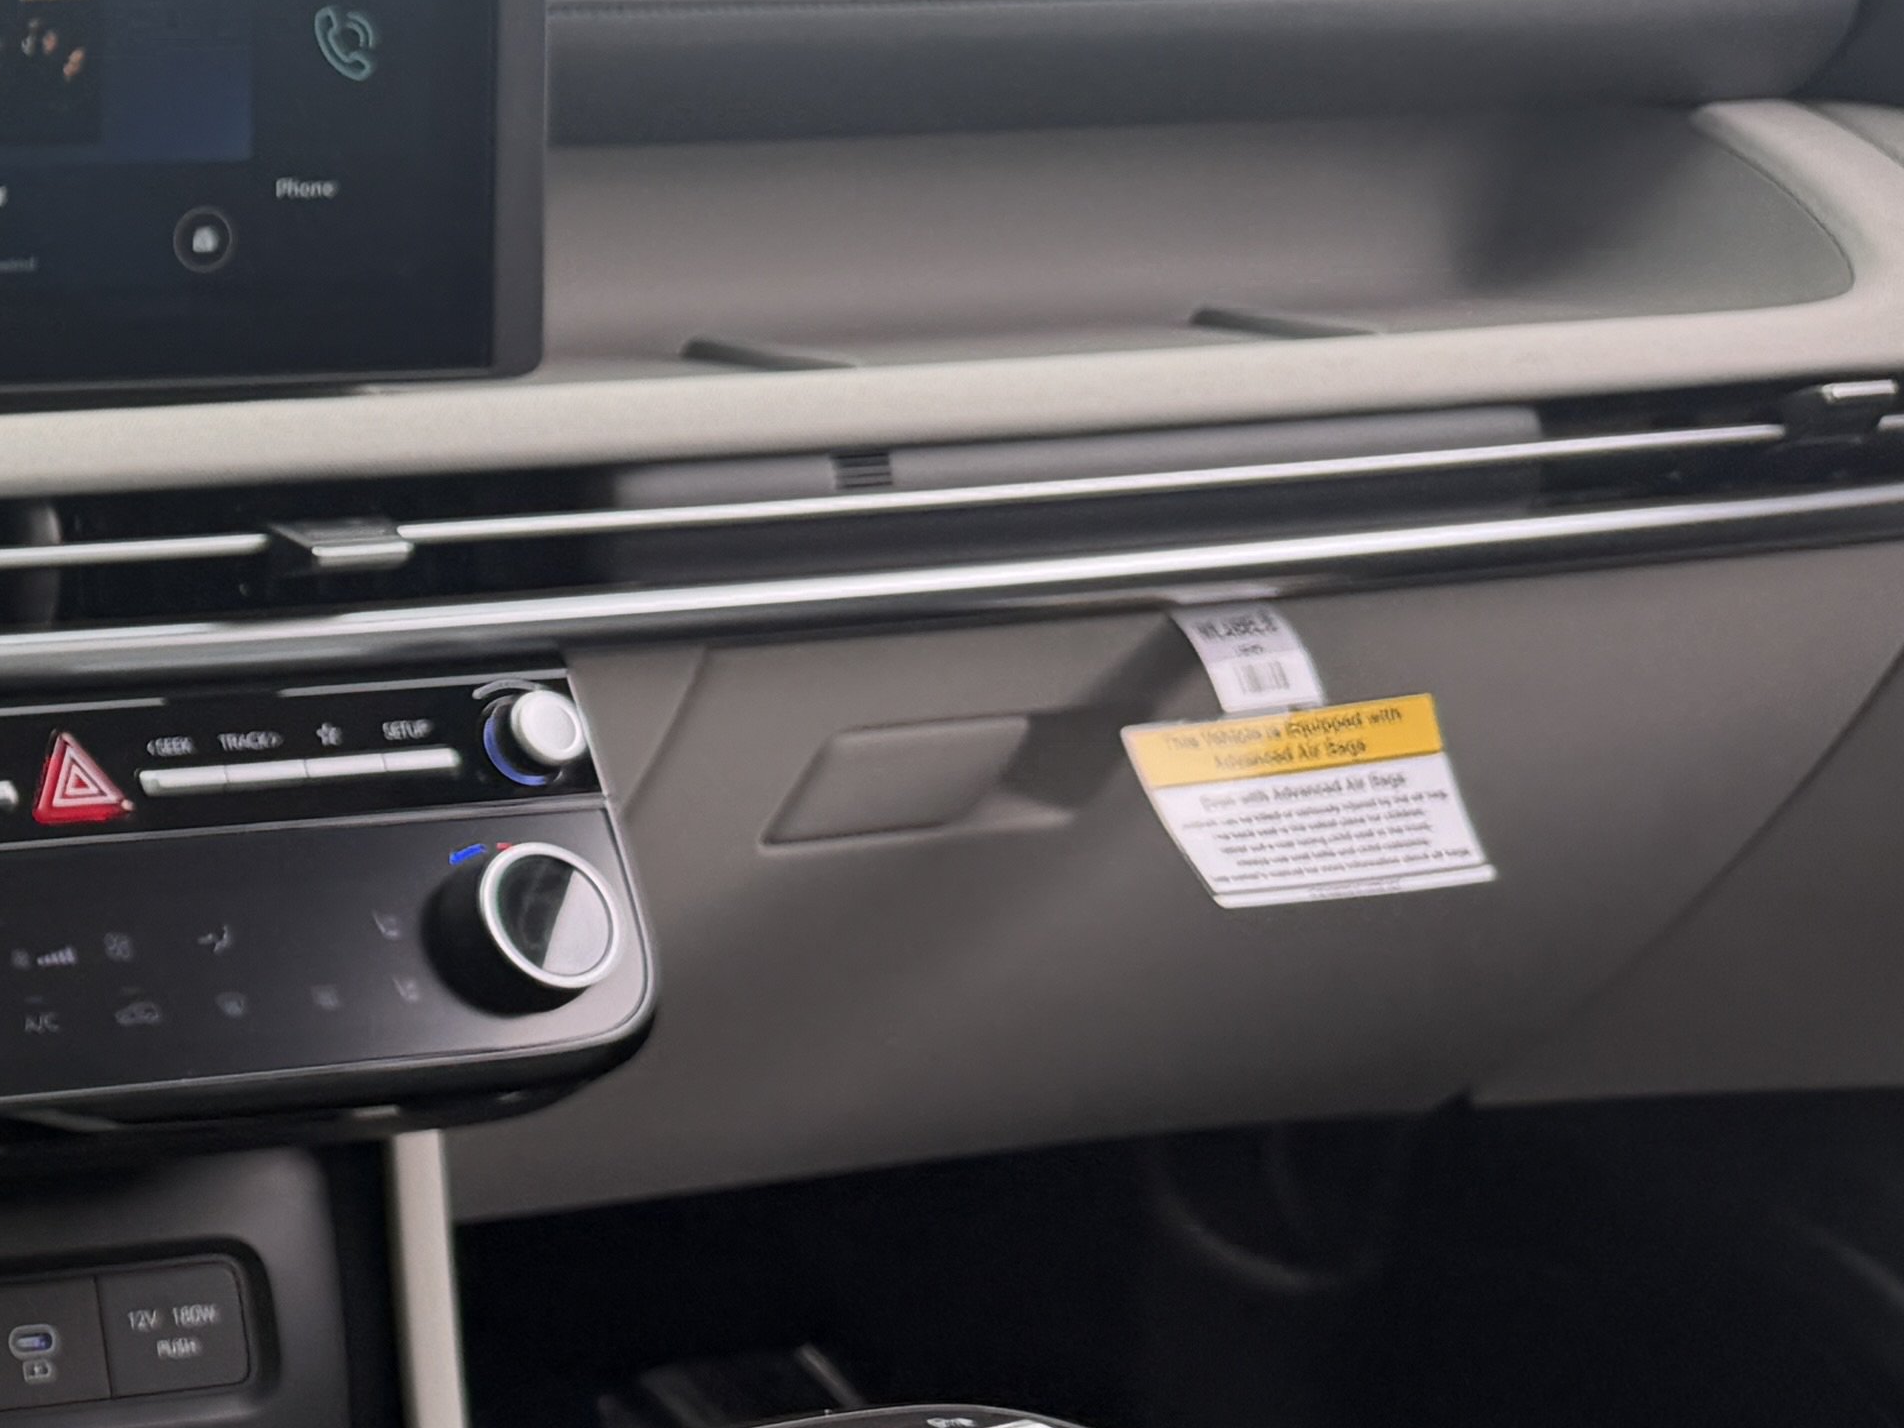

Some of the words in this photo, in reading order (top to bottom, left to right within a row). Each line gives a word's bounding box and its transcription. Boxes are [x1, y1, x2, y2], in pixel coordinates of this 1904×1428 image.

[275, 177, 338, 199] Phone
[383, 719, 435, 741] SETUP
[24, 1012, 60, 1034] A/C
[128, 1309, 157, 1331] 12V
